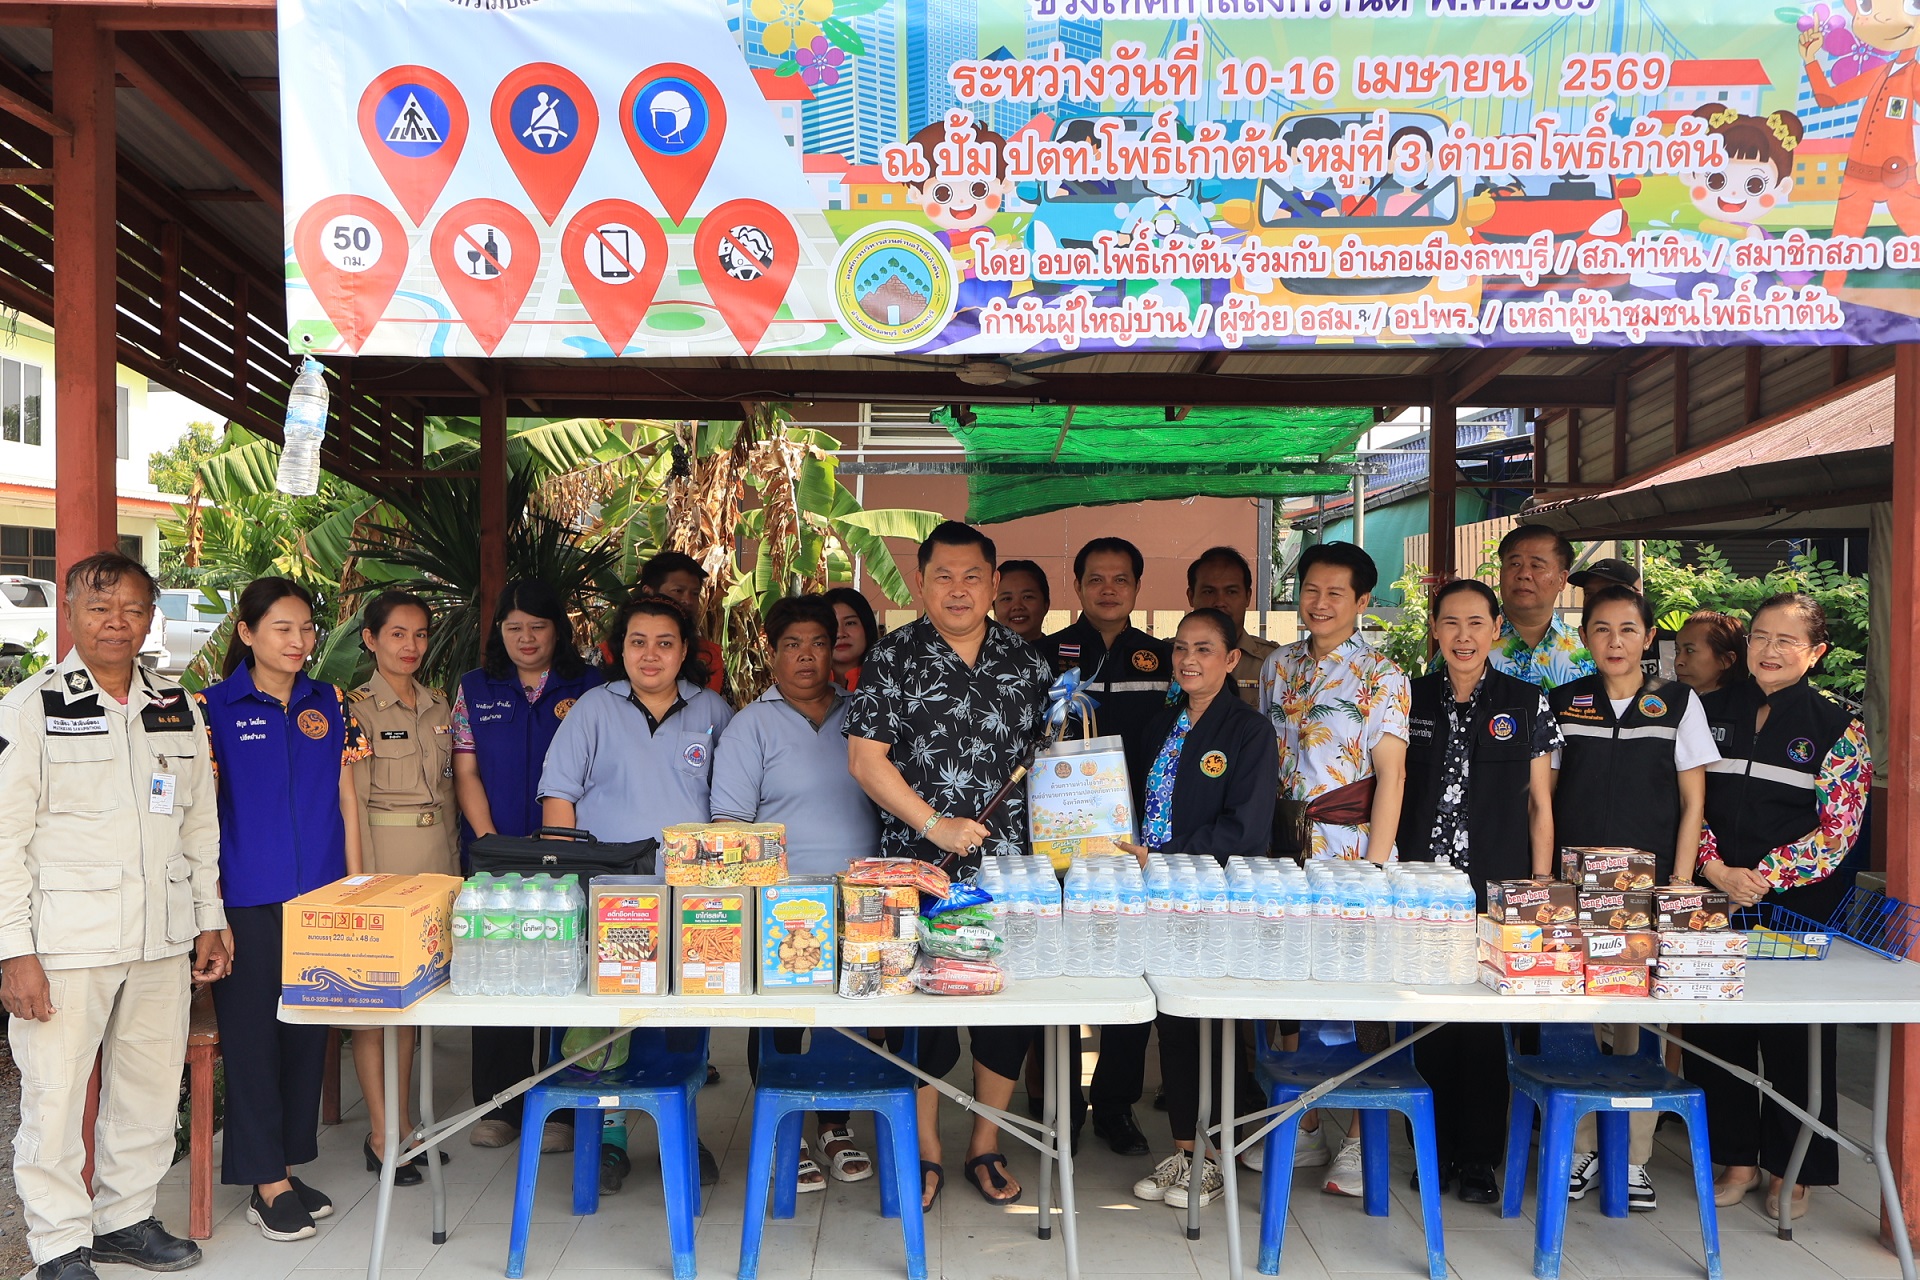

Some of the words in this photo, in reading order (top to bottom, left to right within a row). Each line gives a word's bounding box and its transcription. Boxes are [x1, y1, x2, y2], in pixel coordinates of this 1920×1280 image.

[952, 30, 1199, 97] ระหว่างวันที่
[1221, 62, 1335, 96] 10-16
[1356, 60, 1527, 95] เมษายน
[1563, 58, 1667, 92] 2569
[885, 148, 925, 177] ณ
[939, 113, 991, 176] ปั้ม
[1008, 110, 1287, 176] ปตท.โพธิ์เก้าต้น
[1303, 116, 1385, 189] หมู่ที่
[1400, 140, 1422, 173] 3
[1438, 105, 1724, 174] ตำบลโพธิ์เก้าต้น
[333, 226, 371, 251] 50
[343, 255, 366, 266] กม.
[975, 237, 1025, 275] โดย
[1037, 227, 1232, 275] อบต.โพธิ์เก้าต้น
[1241, 241, 1326, 275] ร่วมกับ
[1339, 235, 1549, 282] อำเภอเมืองลพบุรี
[1582, 236, 1702, 270] สภ.ท่าหิน
[1735, 233, 1879, 267] สมาชิกสภา
[984, 294, 1187, 345] กำนันผู้ใหญ่บ้าน
[1220, 297, 1288, 343] ผู้ช่วย
[1300, 307, 1360, 331] อสม.
[1394, 300, 1475, 329] อปพร.
[1506, 279, 1839, 338] เหล่าผู้นำชุมชนโพธิ์เก้าต้น
[332, 933, 345, 942] 220
[359, 934, 369, 943] 48
